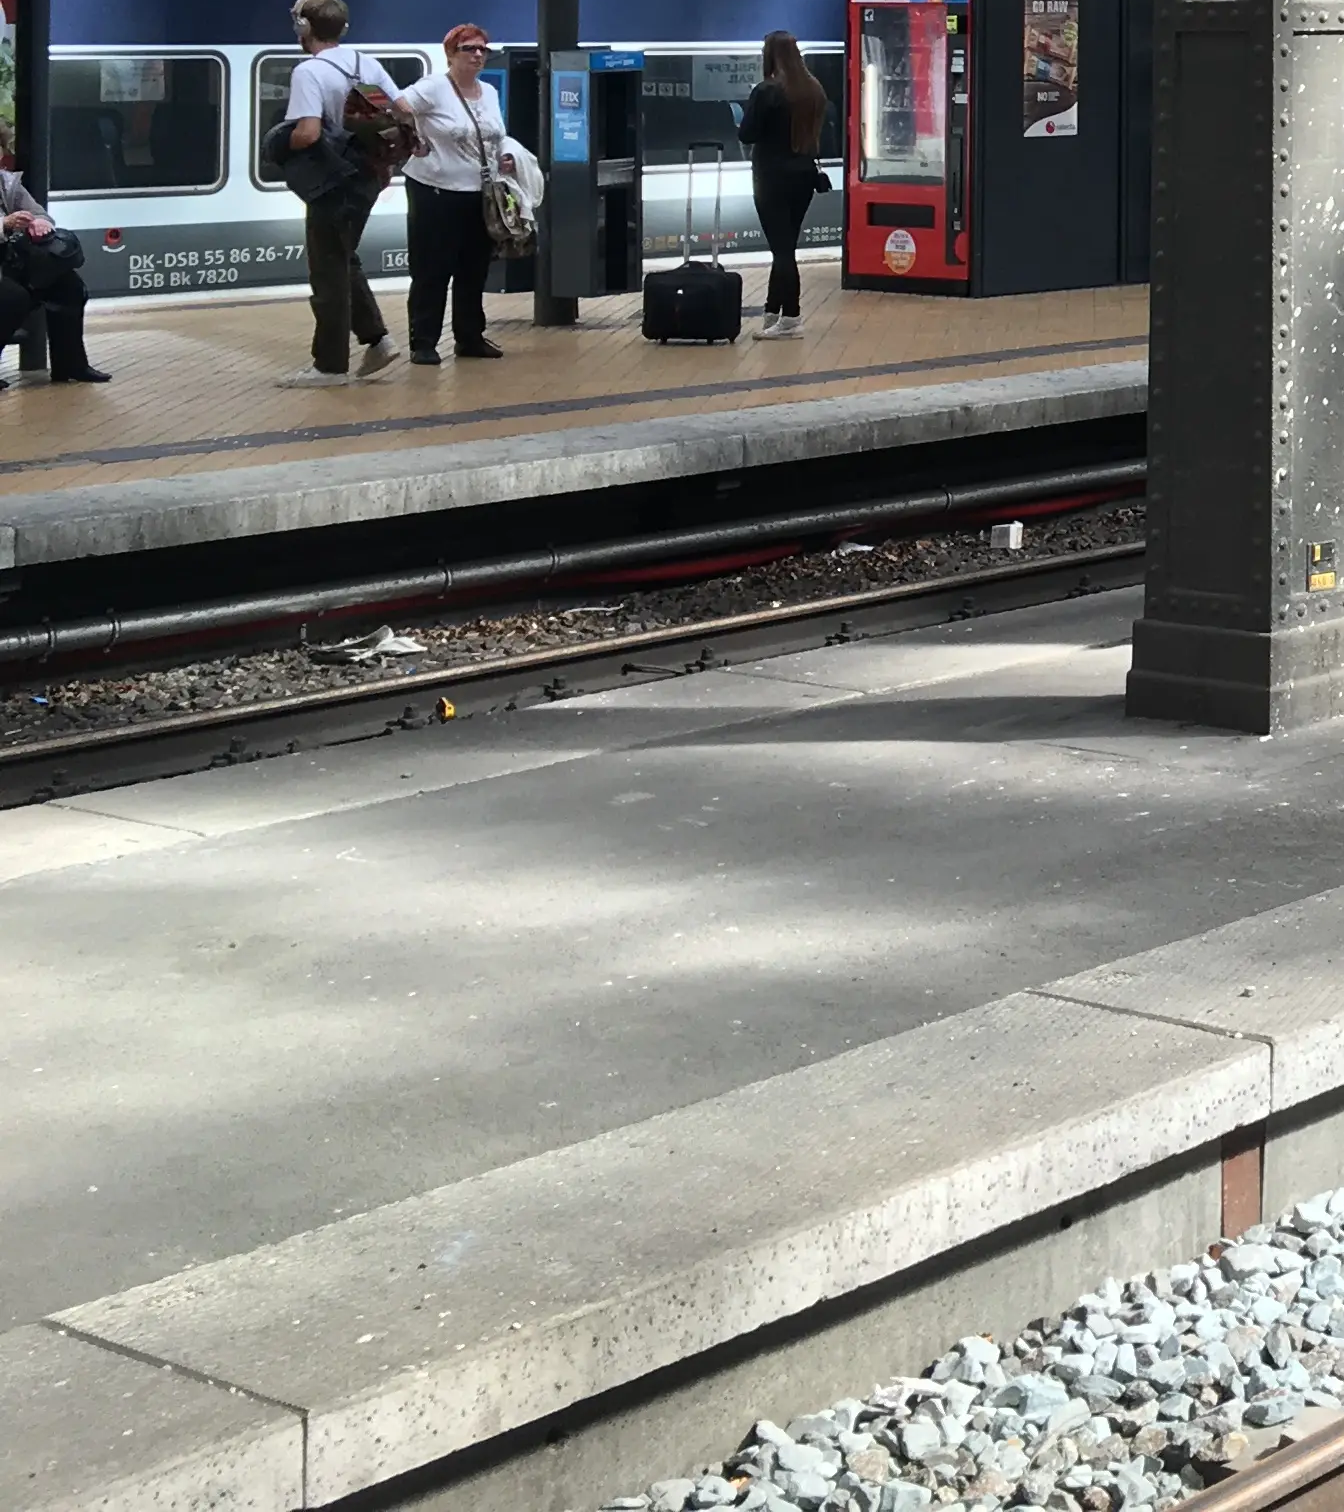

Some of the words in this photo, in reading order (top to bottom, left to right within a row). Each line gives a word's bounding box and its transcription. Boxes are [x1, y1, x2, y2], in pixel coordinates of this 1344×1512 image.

[1032, 0, 1045, 13] GO
[1047, 0, 1069, 13] RAW
[560, 90, 580, 103] mx
[129, 251, 200, 271] DK-DSB
[203, 249, 225, 265] 55
[229, 248, 250, 264] 86
[255, 244, 305, 262] 26-77
[129, 273, 165, 289] DSB
[170, 271, 192, 286] Bk
[197, 267, 239, 284] 7820
